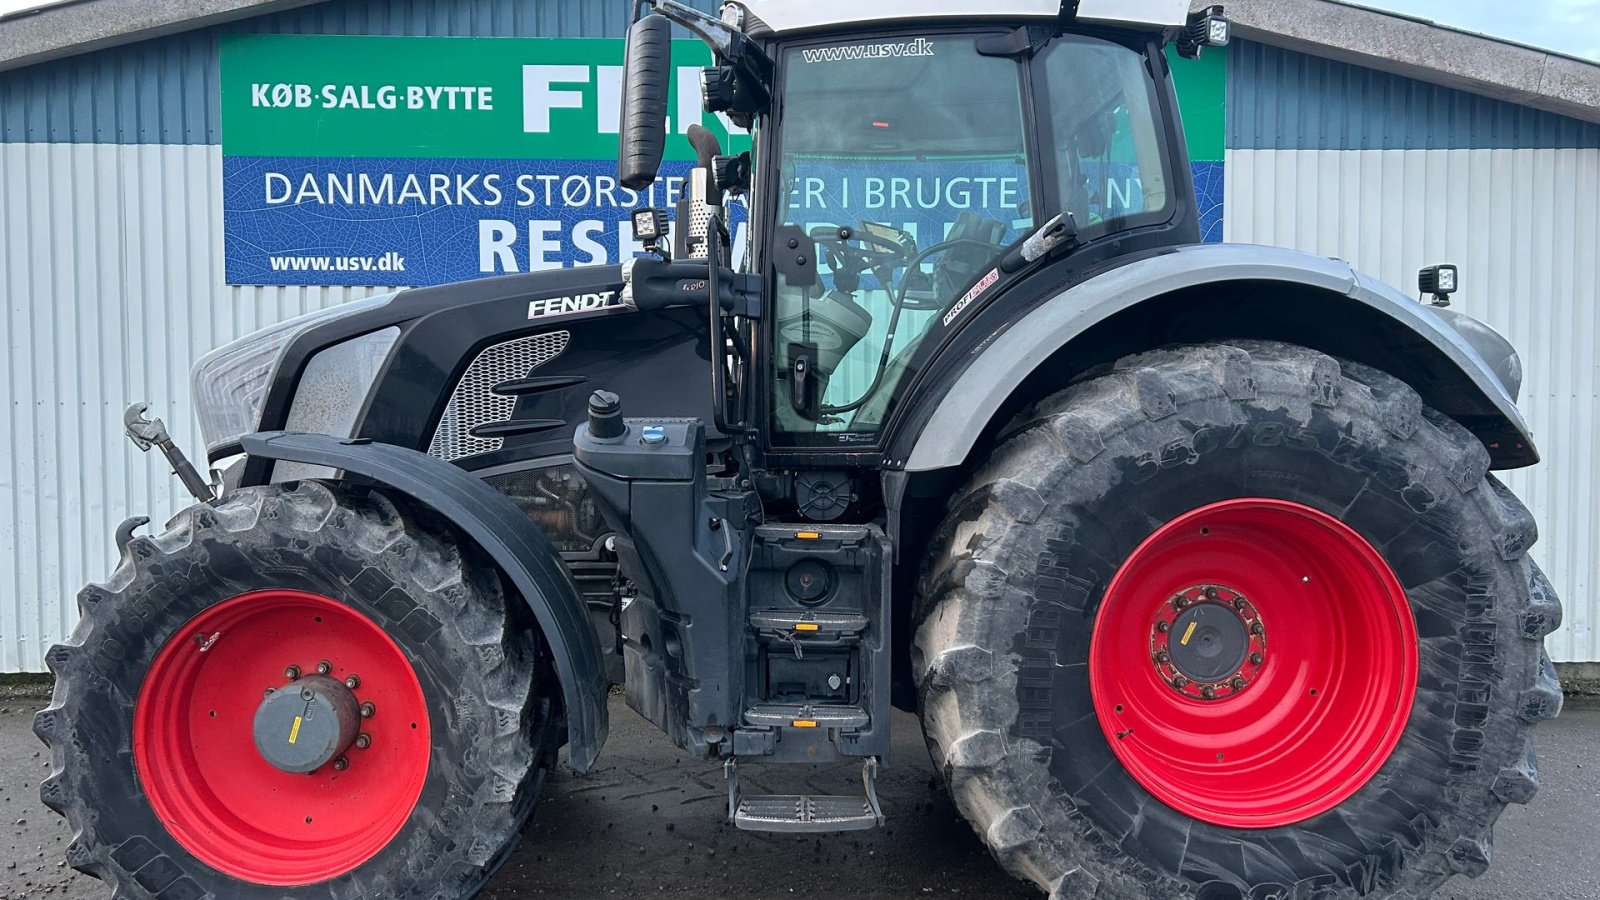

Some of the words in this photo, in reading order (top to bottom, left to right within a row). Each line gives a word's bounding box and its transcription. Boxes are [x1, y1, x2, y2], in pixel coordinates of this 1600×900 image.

[802, 37, 934, 64] www.usv.dk
[264, 172, 502, 206] DANMARKS
[516, 174, 684, 209] STØRSTE
[865, 176, 1018, 210] BRUGTE
[269, 252, 405, 271] www.usv.dk
[528, 290, 616, 320] FENDT
